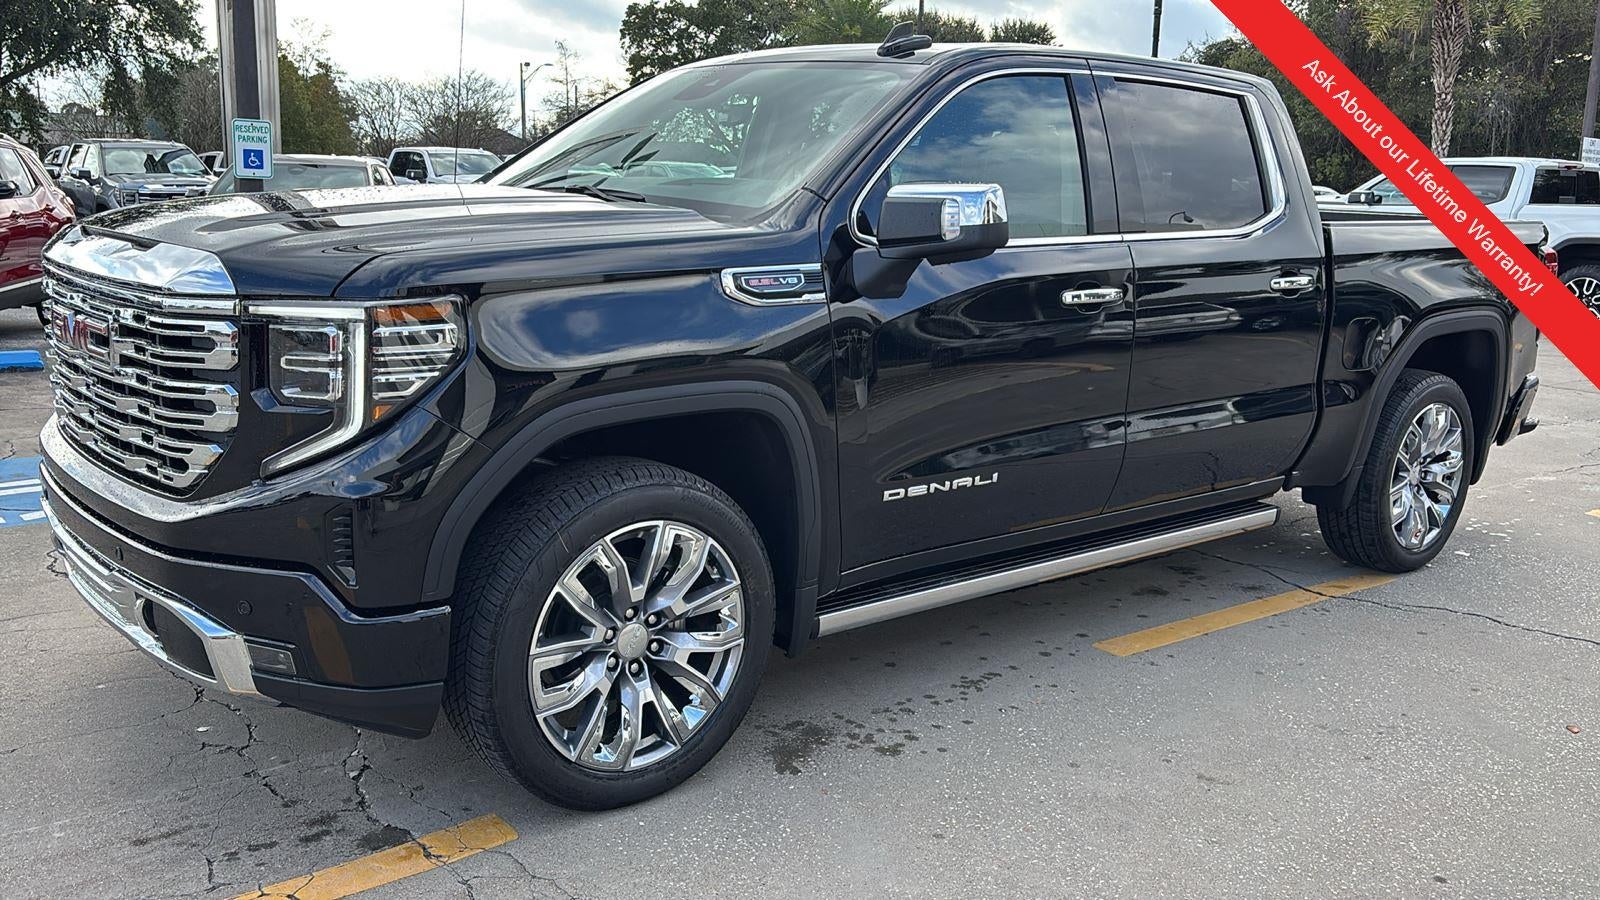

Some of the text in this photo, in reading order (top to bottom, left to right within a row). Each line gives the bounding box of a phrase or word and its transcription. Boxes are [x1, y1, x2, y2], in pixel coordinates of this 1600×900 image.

[235, 124, 269, 134] RESERVED
[238, 134, 267, 144] PARKING
[52, 304, 109, 360] GMC
[883, 472, 998, 502] DENALI
